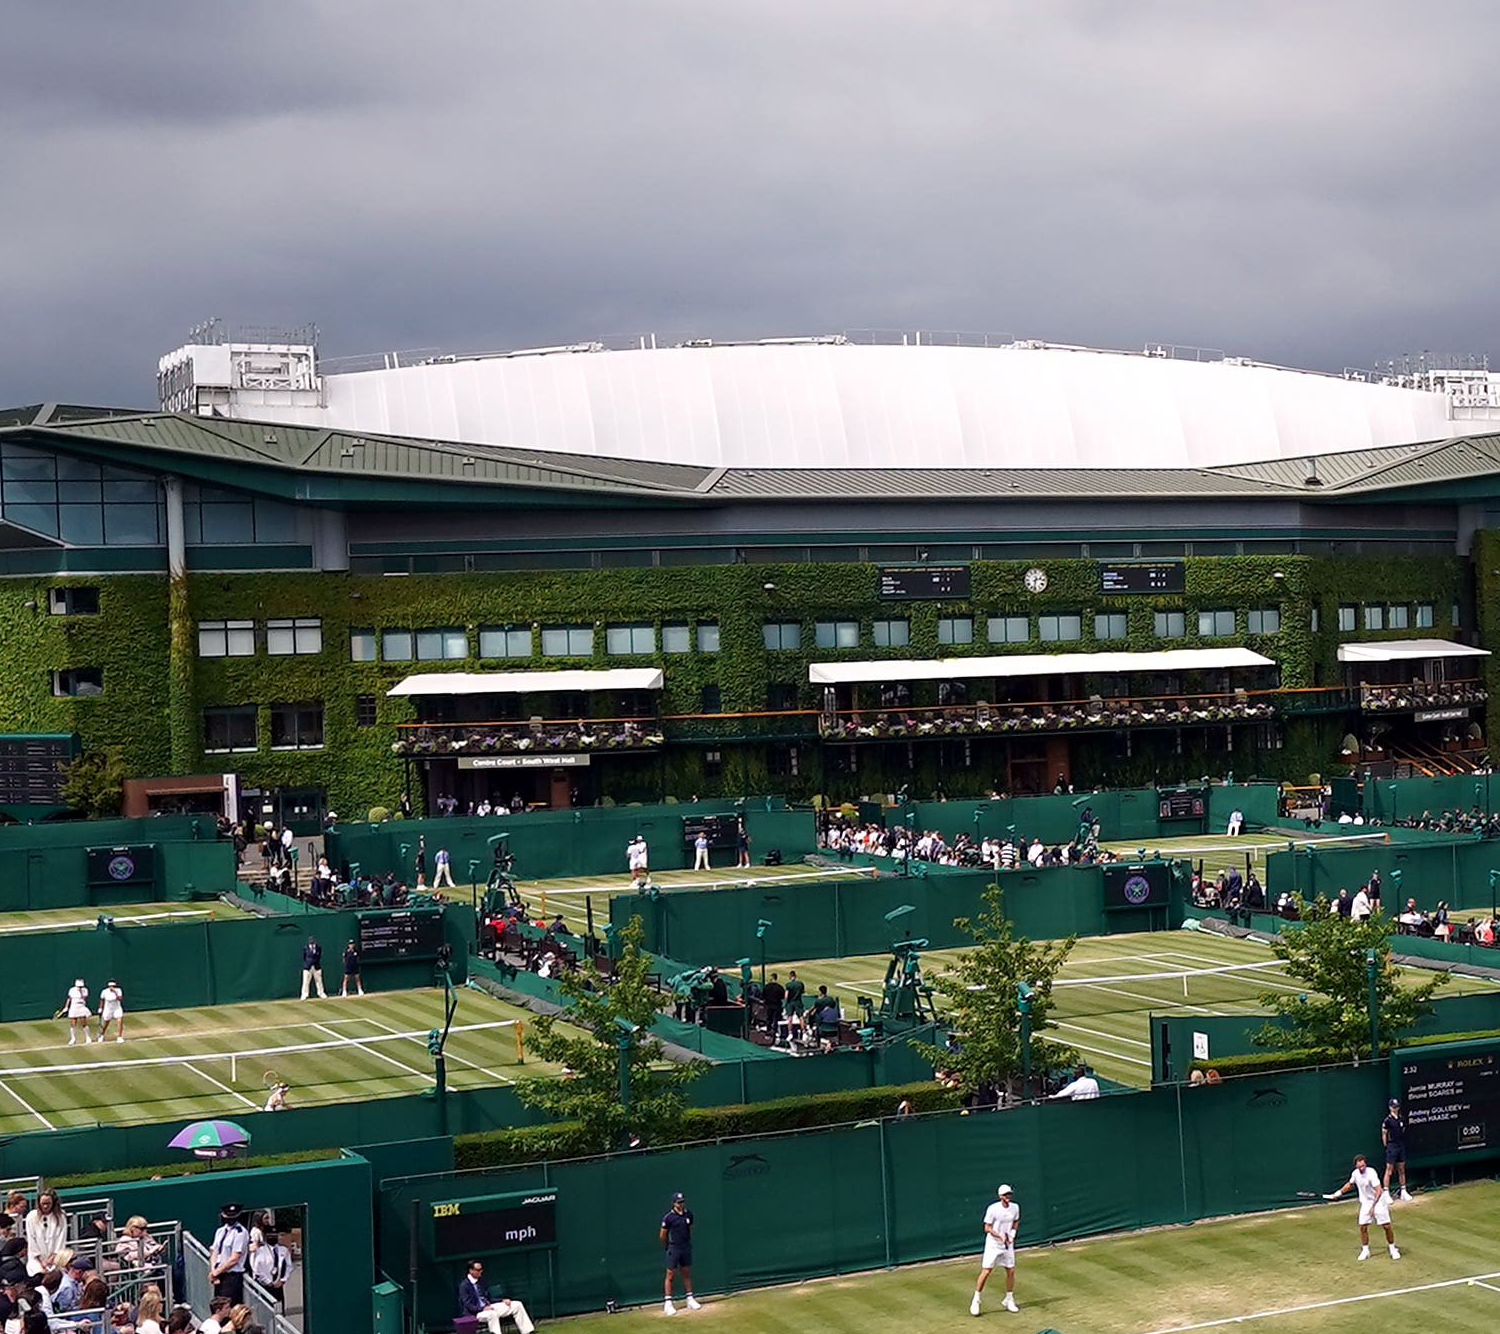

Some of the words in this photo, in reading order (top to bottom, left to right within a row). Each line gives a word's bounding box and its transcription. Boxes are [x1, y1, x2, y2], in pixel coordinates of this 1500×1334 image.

[472, 759, 496, 767] Centre
[497, 758, 516, 766] Court
[522, 757, 542, 765] South
[1457, 1058, 1484, 1068] ROLEX
[1427, 1081, 1455, 1090] MURRAY
[1428, 1088, 1455, 1098] SOARES
[1462, 1125, 1480, 1136] 0:00
[521, 1194, 557, 1205] JAGUAR
[433, 1203, 461, 1218] IBM
[505, 1225, 537, 1242] mph
